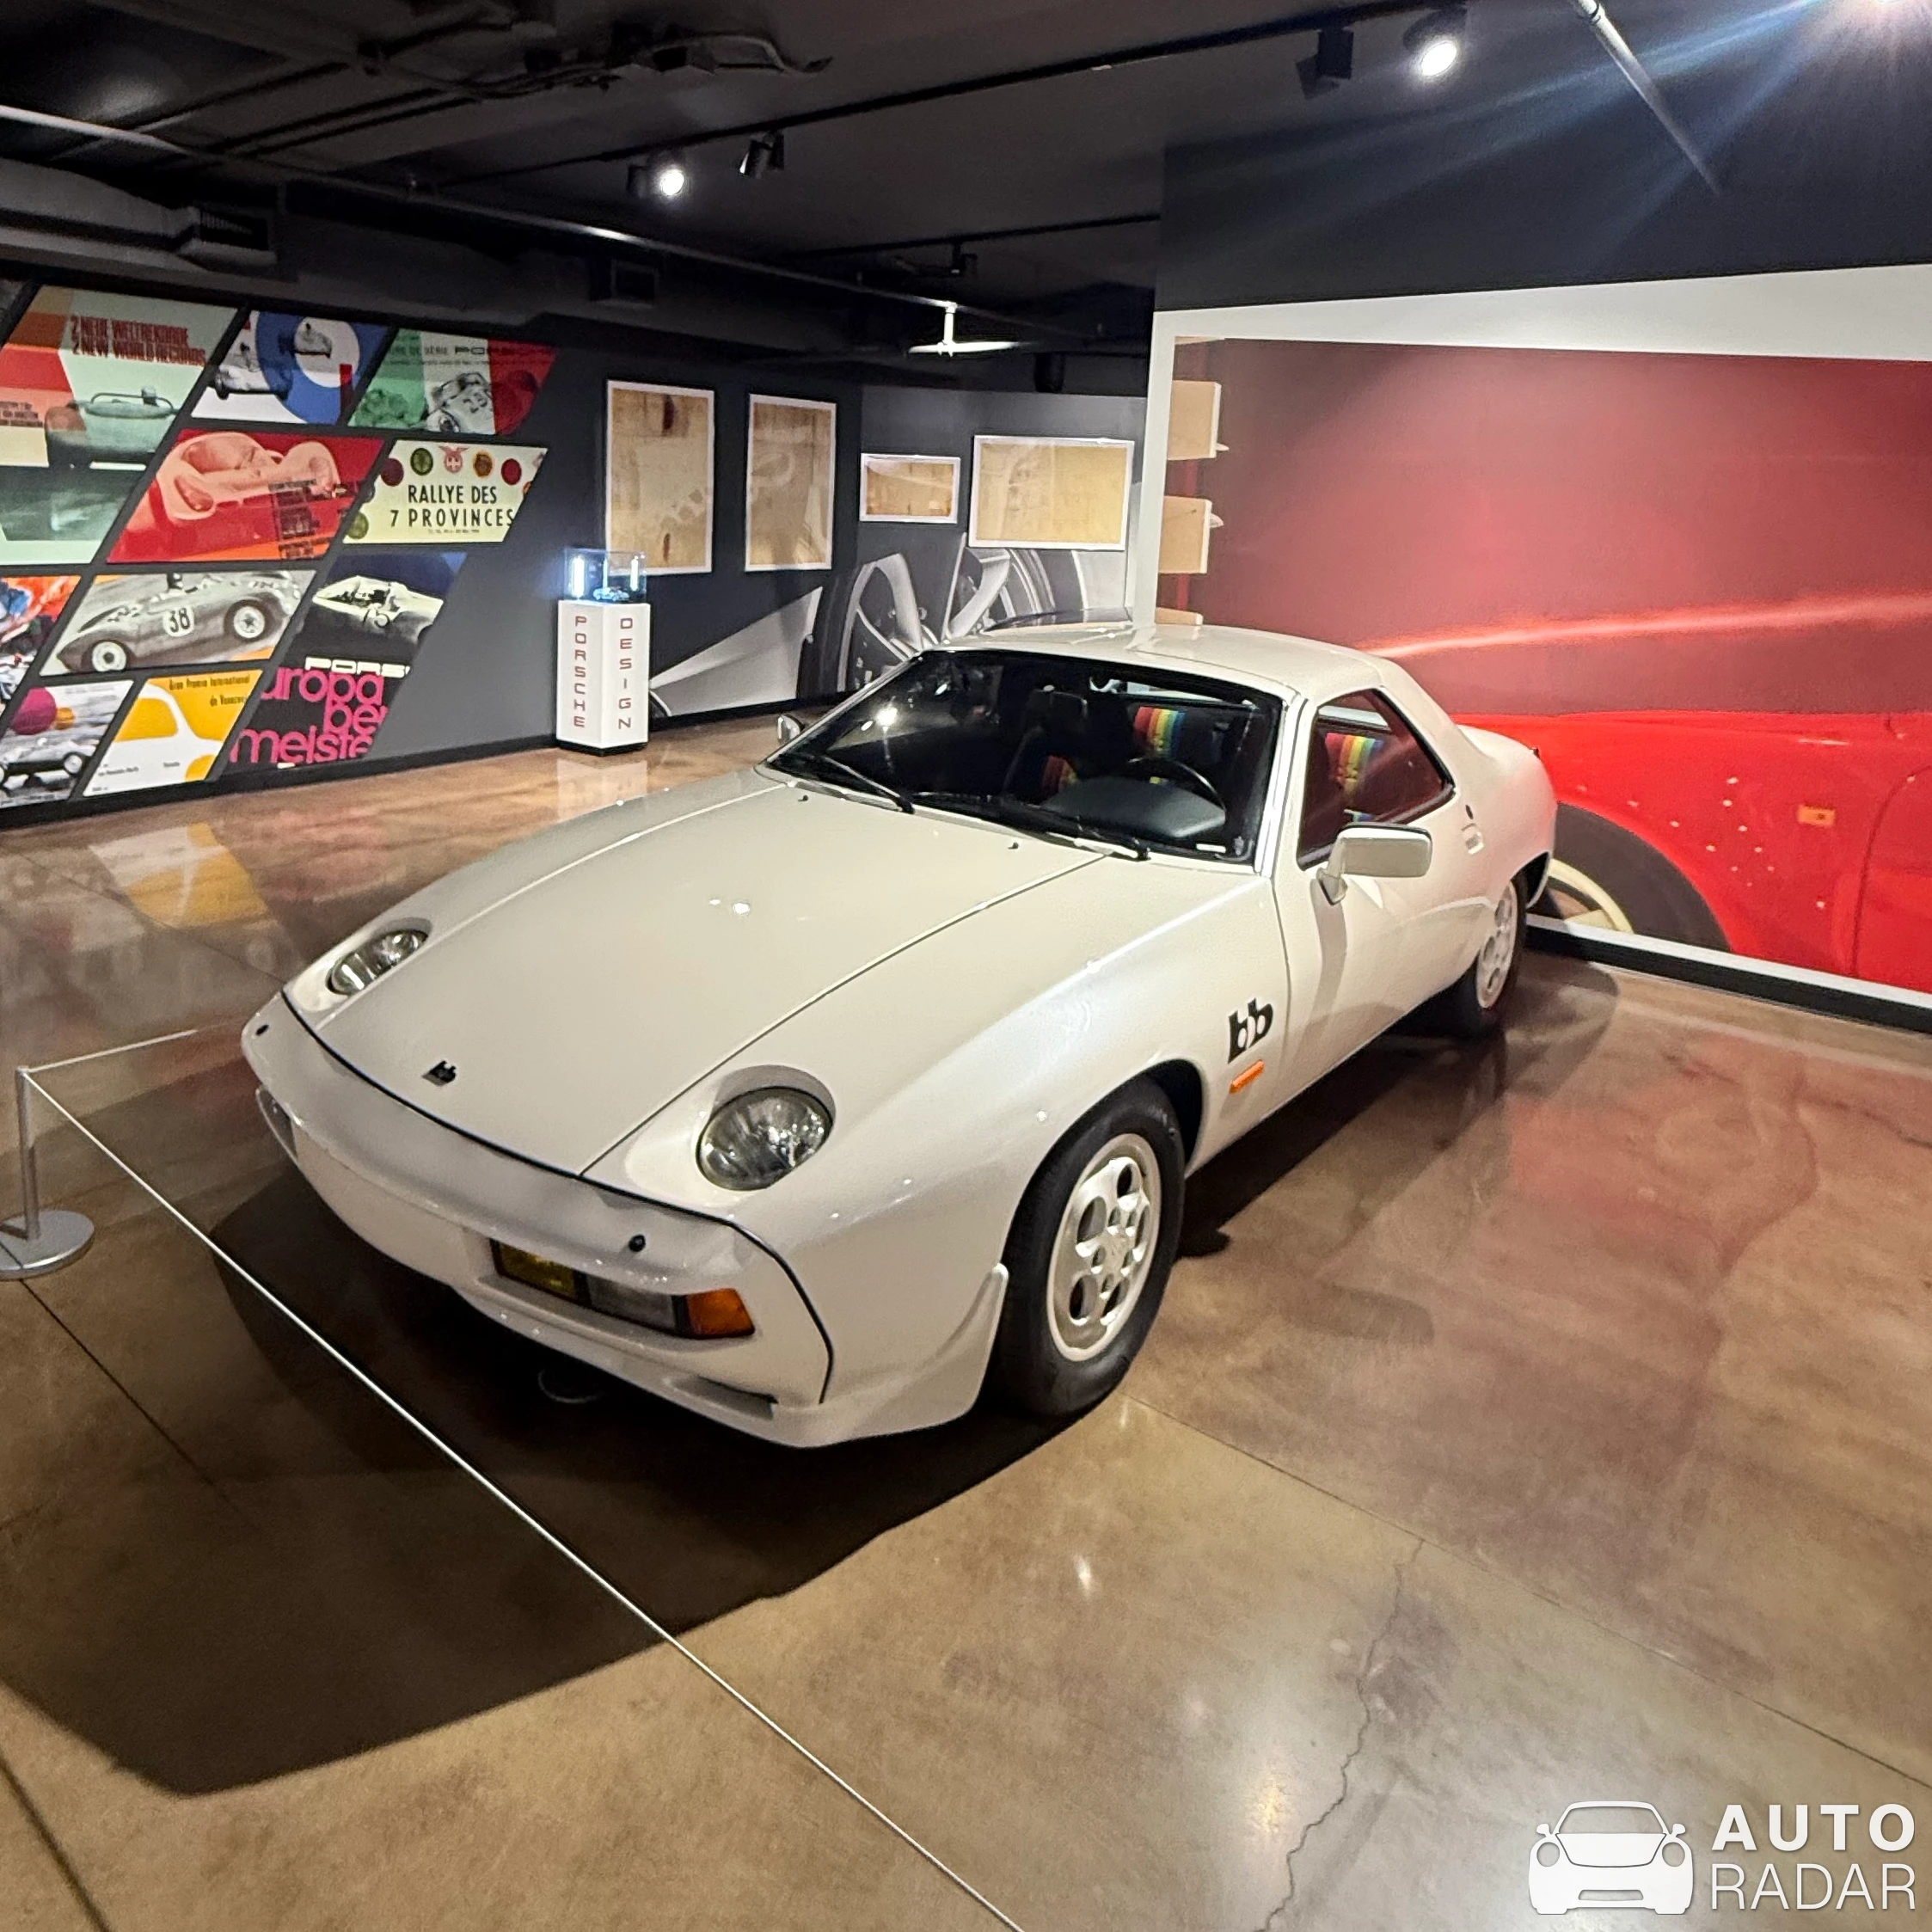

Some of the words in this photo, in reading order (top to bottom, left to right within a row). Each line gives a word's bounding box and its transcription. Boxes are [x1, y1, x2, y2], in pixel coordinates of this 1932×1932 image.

[408, 485, 463, 503] RALLYE
[471, 486, 497, 504] DES
[390, 510, 399, 526] 7
[408, 509, 515, 526] PROVINCES
[169, 608, 191, 632] 38
[573, 616, 587, 728] PORSCHE
[618, 618, 633, 729] DESIGN
